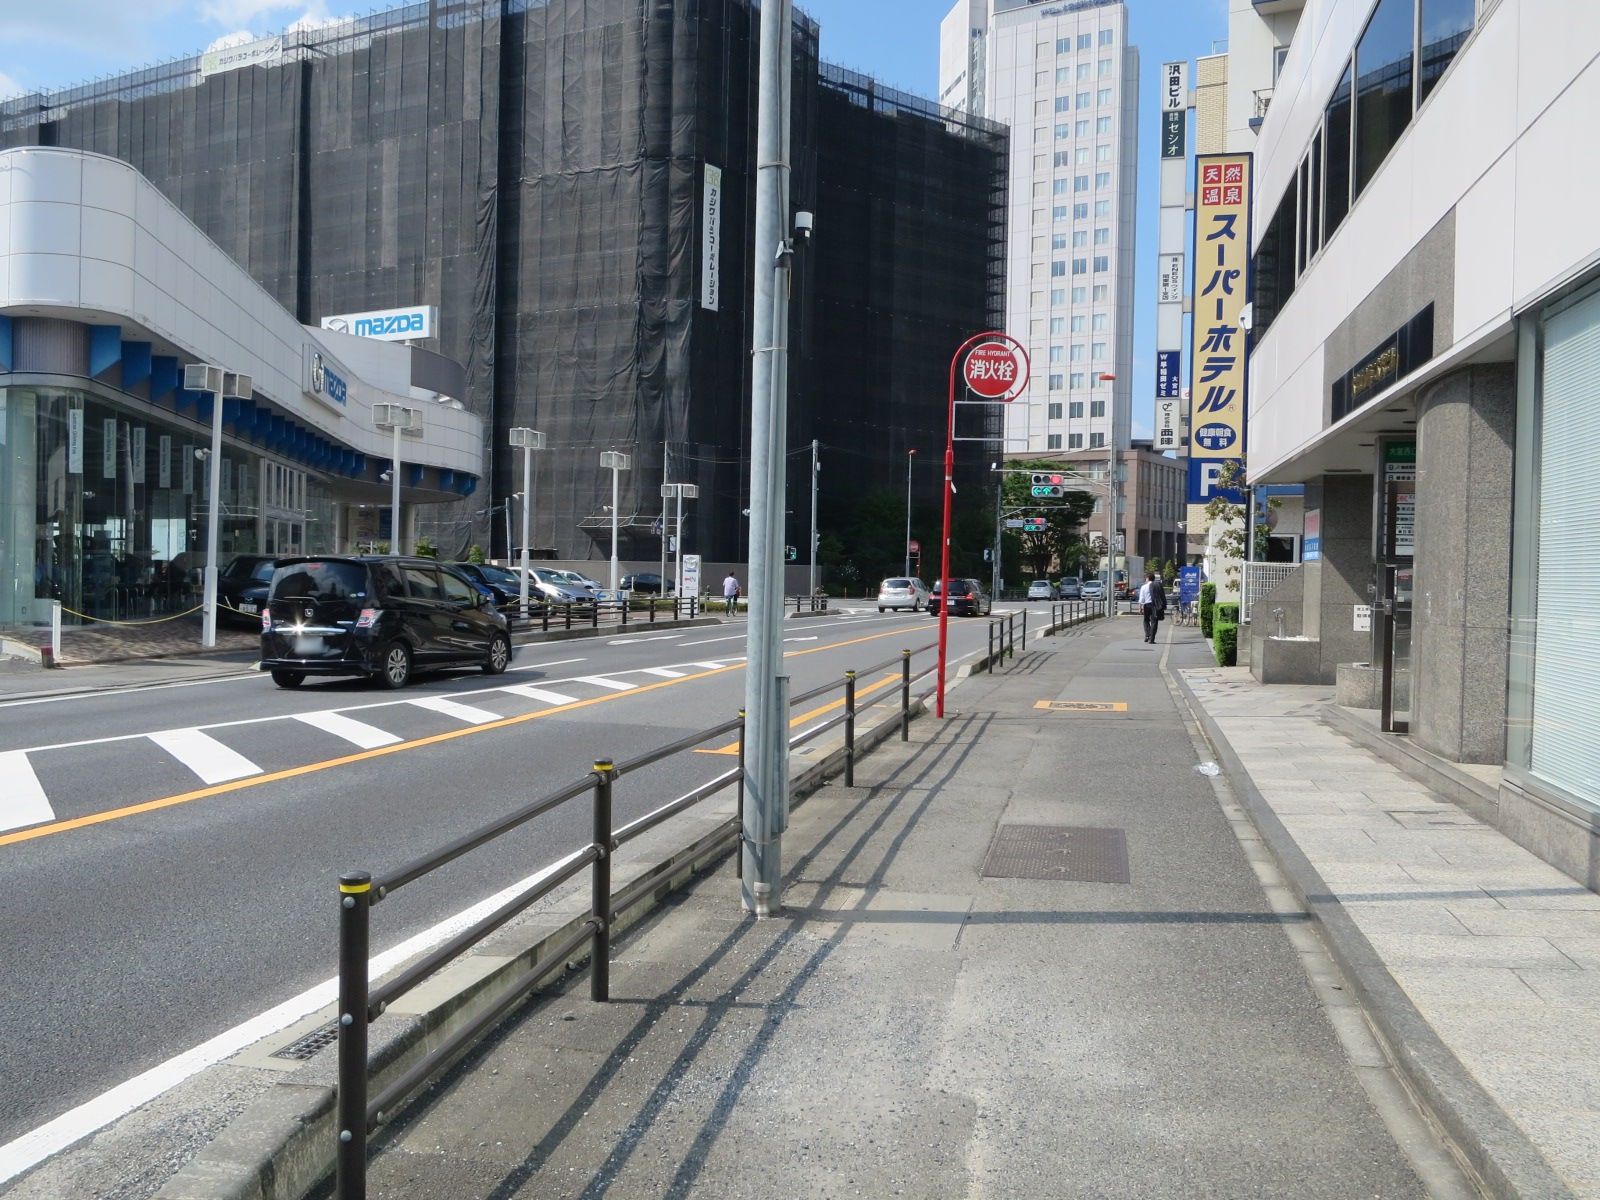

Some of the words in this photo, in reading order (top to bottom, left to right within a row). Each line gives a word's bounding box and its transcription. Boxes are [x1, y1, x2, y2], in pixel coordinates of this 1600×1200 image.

[1168, 65, 1181, 108] 沢田ビル
[1168, 123, 1179, 156] セシオ
[1197, 213, 1240, 413] スーパーホテル
[969, 358, 1015, 381] 消火栓
[1200, 462, 1222, 497] P
